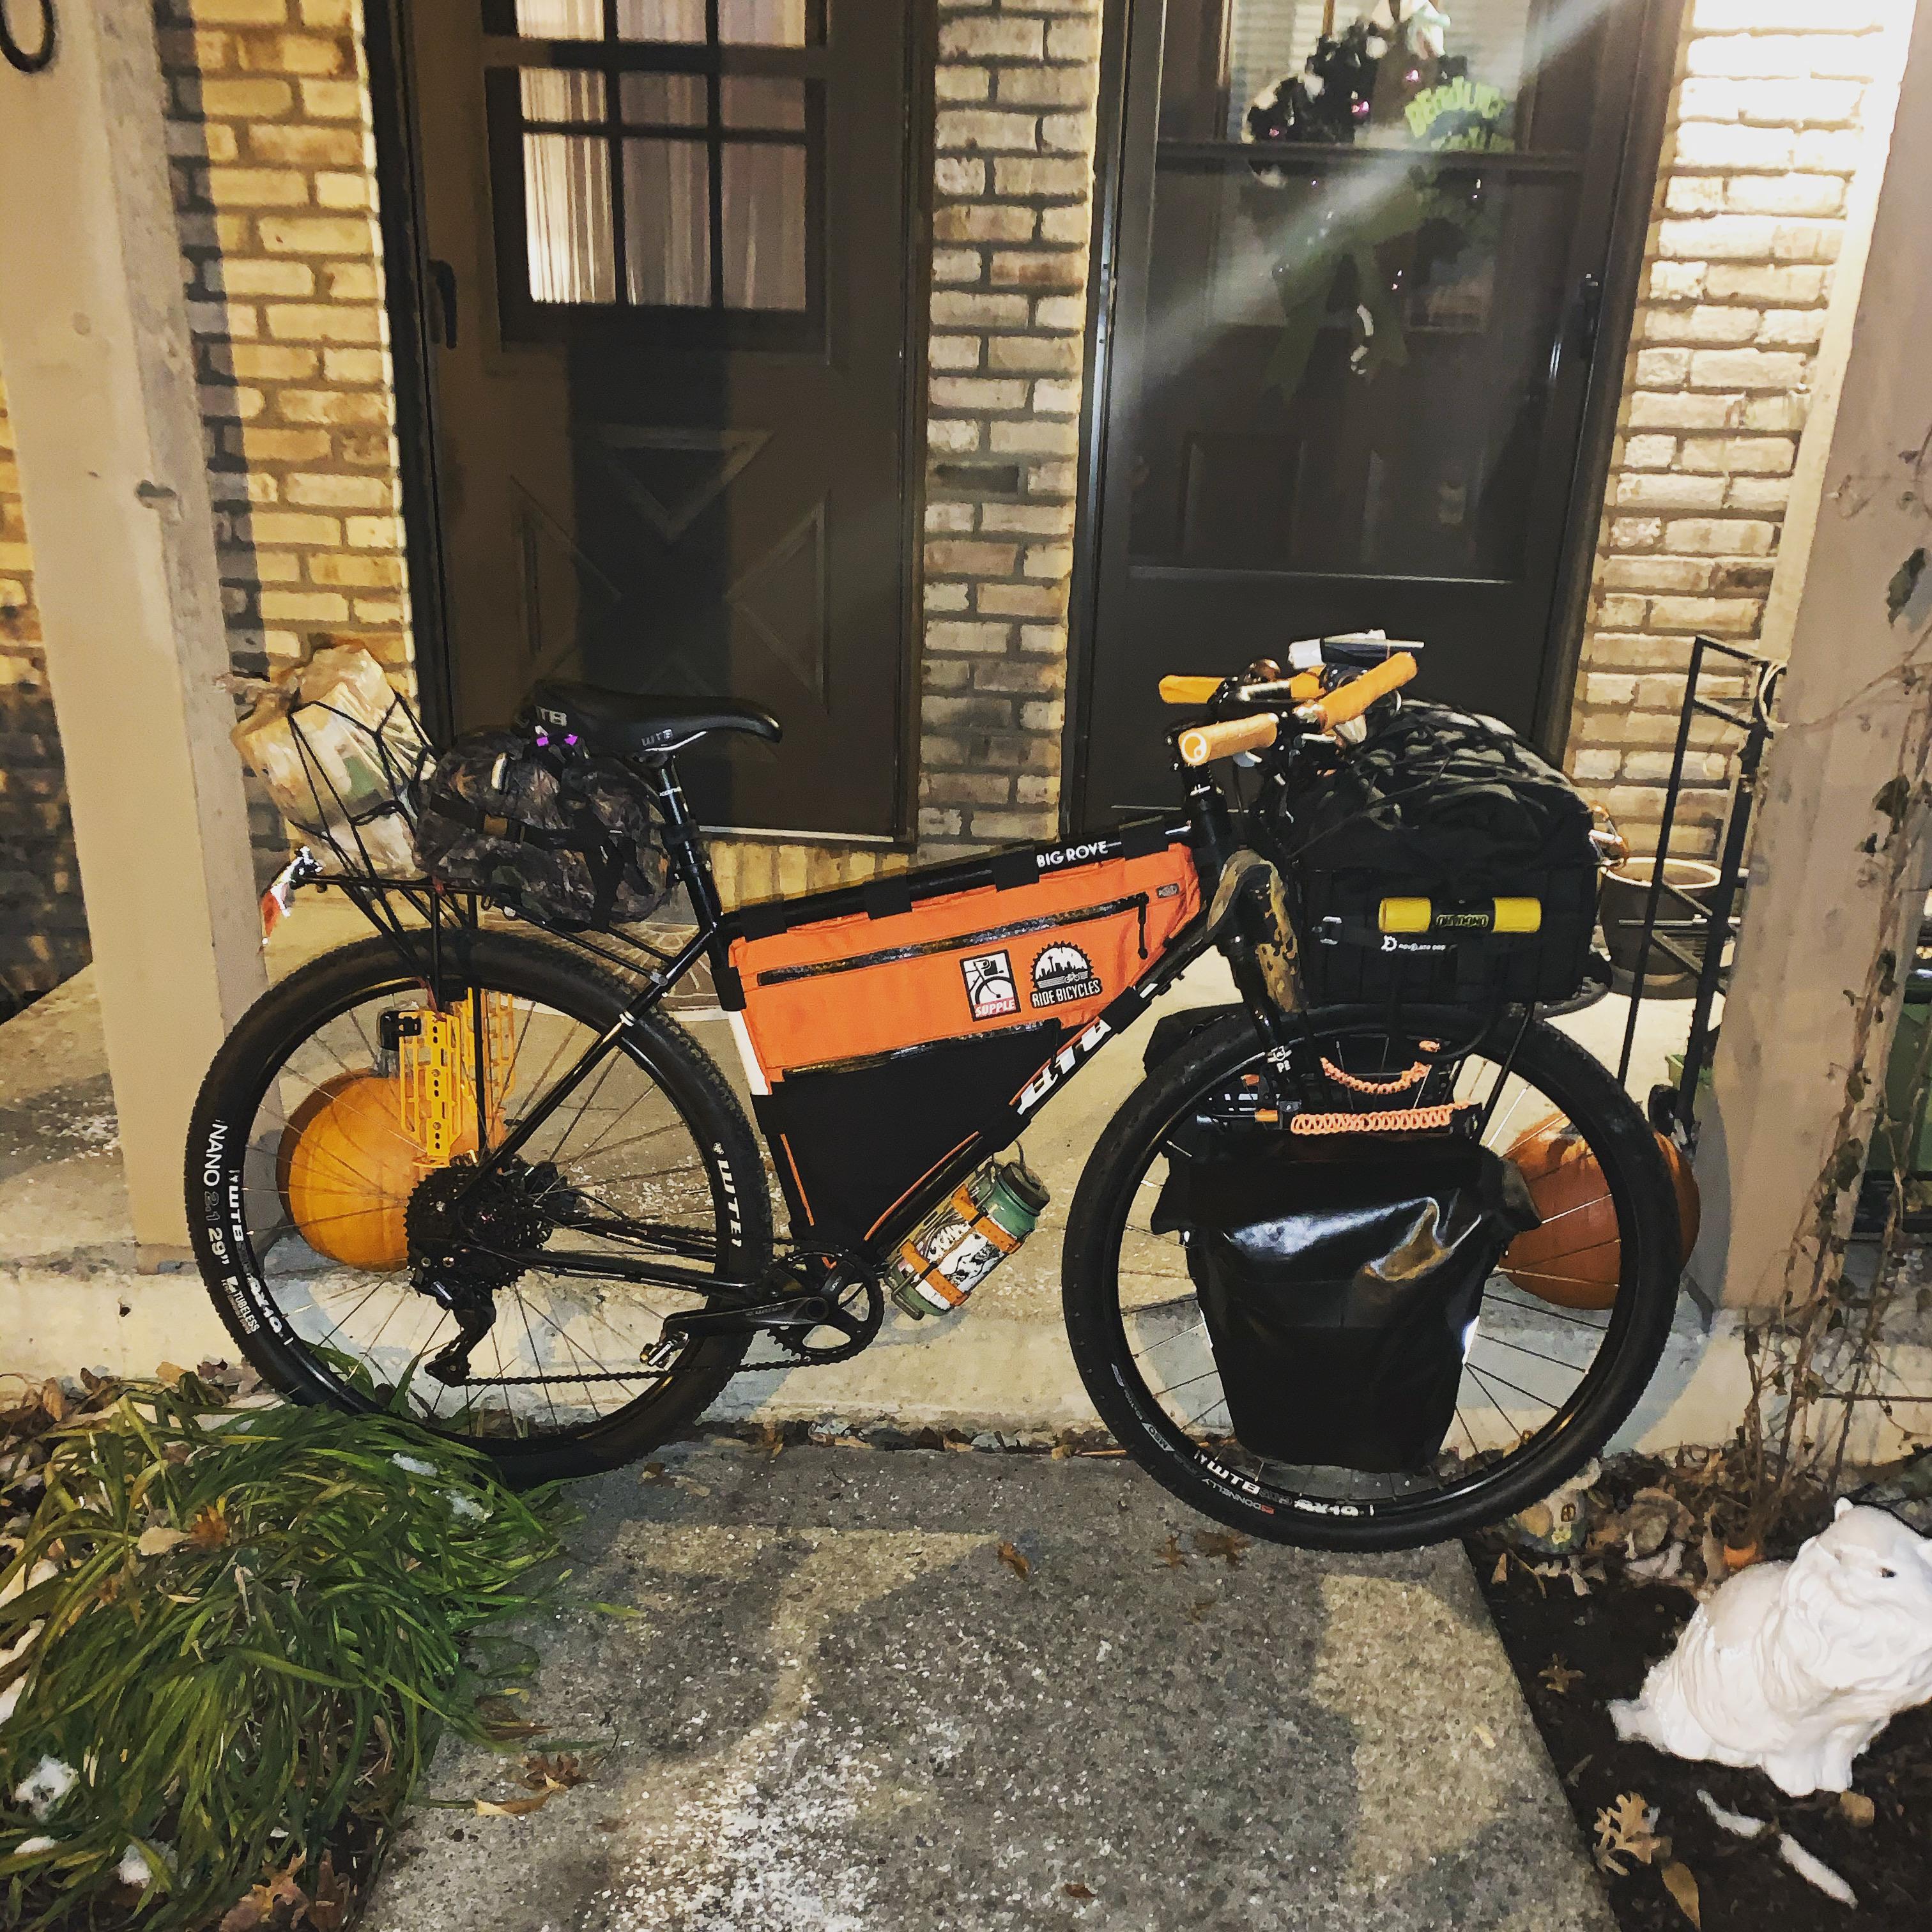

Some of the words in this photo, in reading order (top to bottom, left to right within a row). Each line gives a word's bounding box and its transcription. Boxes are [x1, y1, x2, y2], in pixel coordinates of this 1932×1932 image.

[641, 728, 673, 746] WTB
[1036, 850, 1064, 869] BIG
[1066, 840, 1108, 862] ROVE
[974, 999, 1016, 1018] SUPPLE
[1031, 992, 1055, 1008] RIDE
[1055, 980, 1101, 1002] BICYCLES
[1276, 1060, 1291, 1073] P2
[203, 1121, 228, 1186] NANO
[204, 1191, 221, 1221] 2.1
[228, 1185, 244, 1242] WTB
[233, 1290, 260, 1333] TUBELESS
[1207, 1460, 1262, 1496] WTB
[1201, 1478, 1262, 1511] DONNELLY
